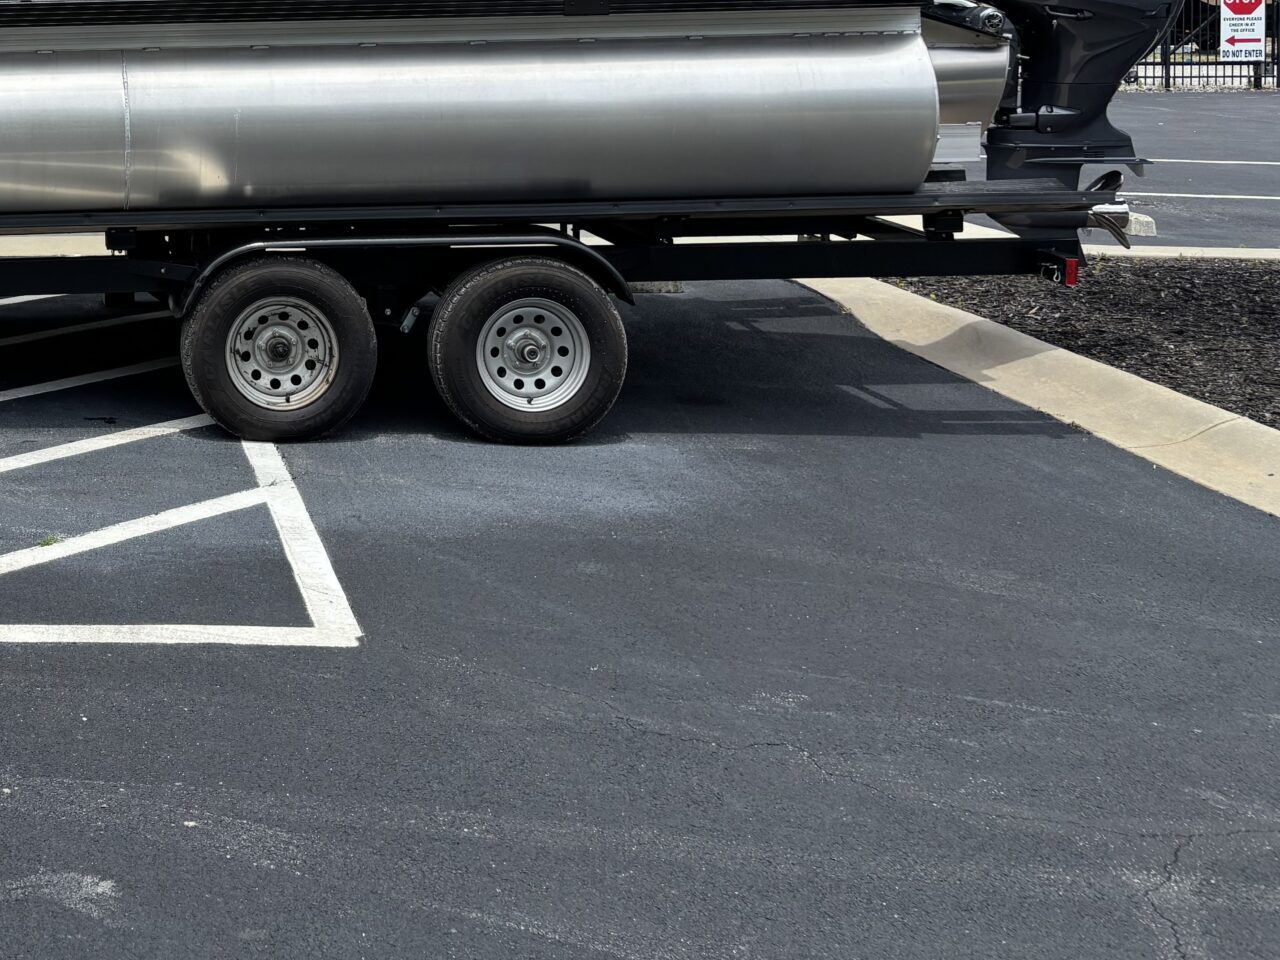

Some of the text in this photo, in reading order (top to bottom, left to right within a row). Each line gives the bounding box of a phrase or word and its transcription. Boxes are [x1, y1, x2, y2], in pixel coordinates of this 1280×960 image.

[1222, 50, 1263, 58] DO NOT ENTER
